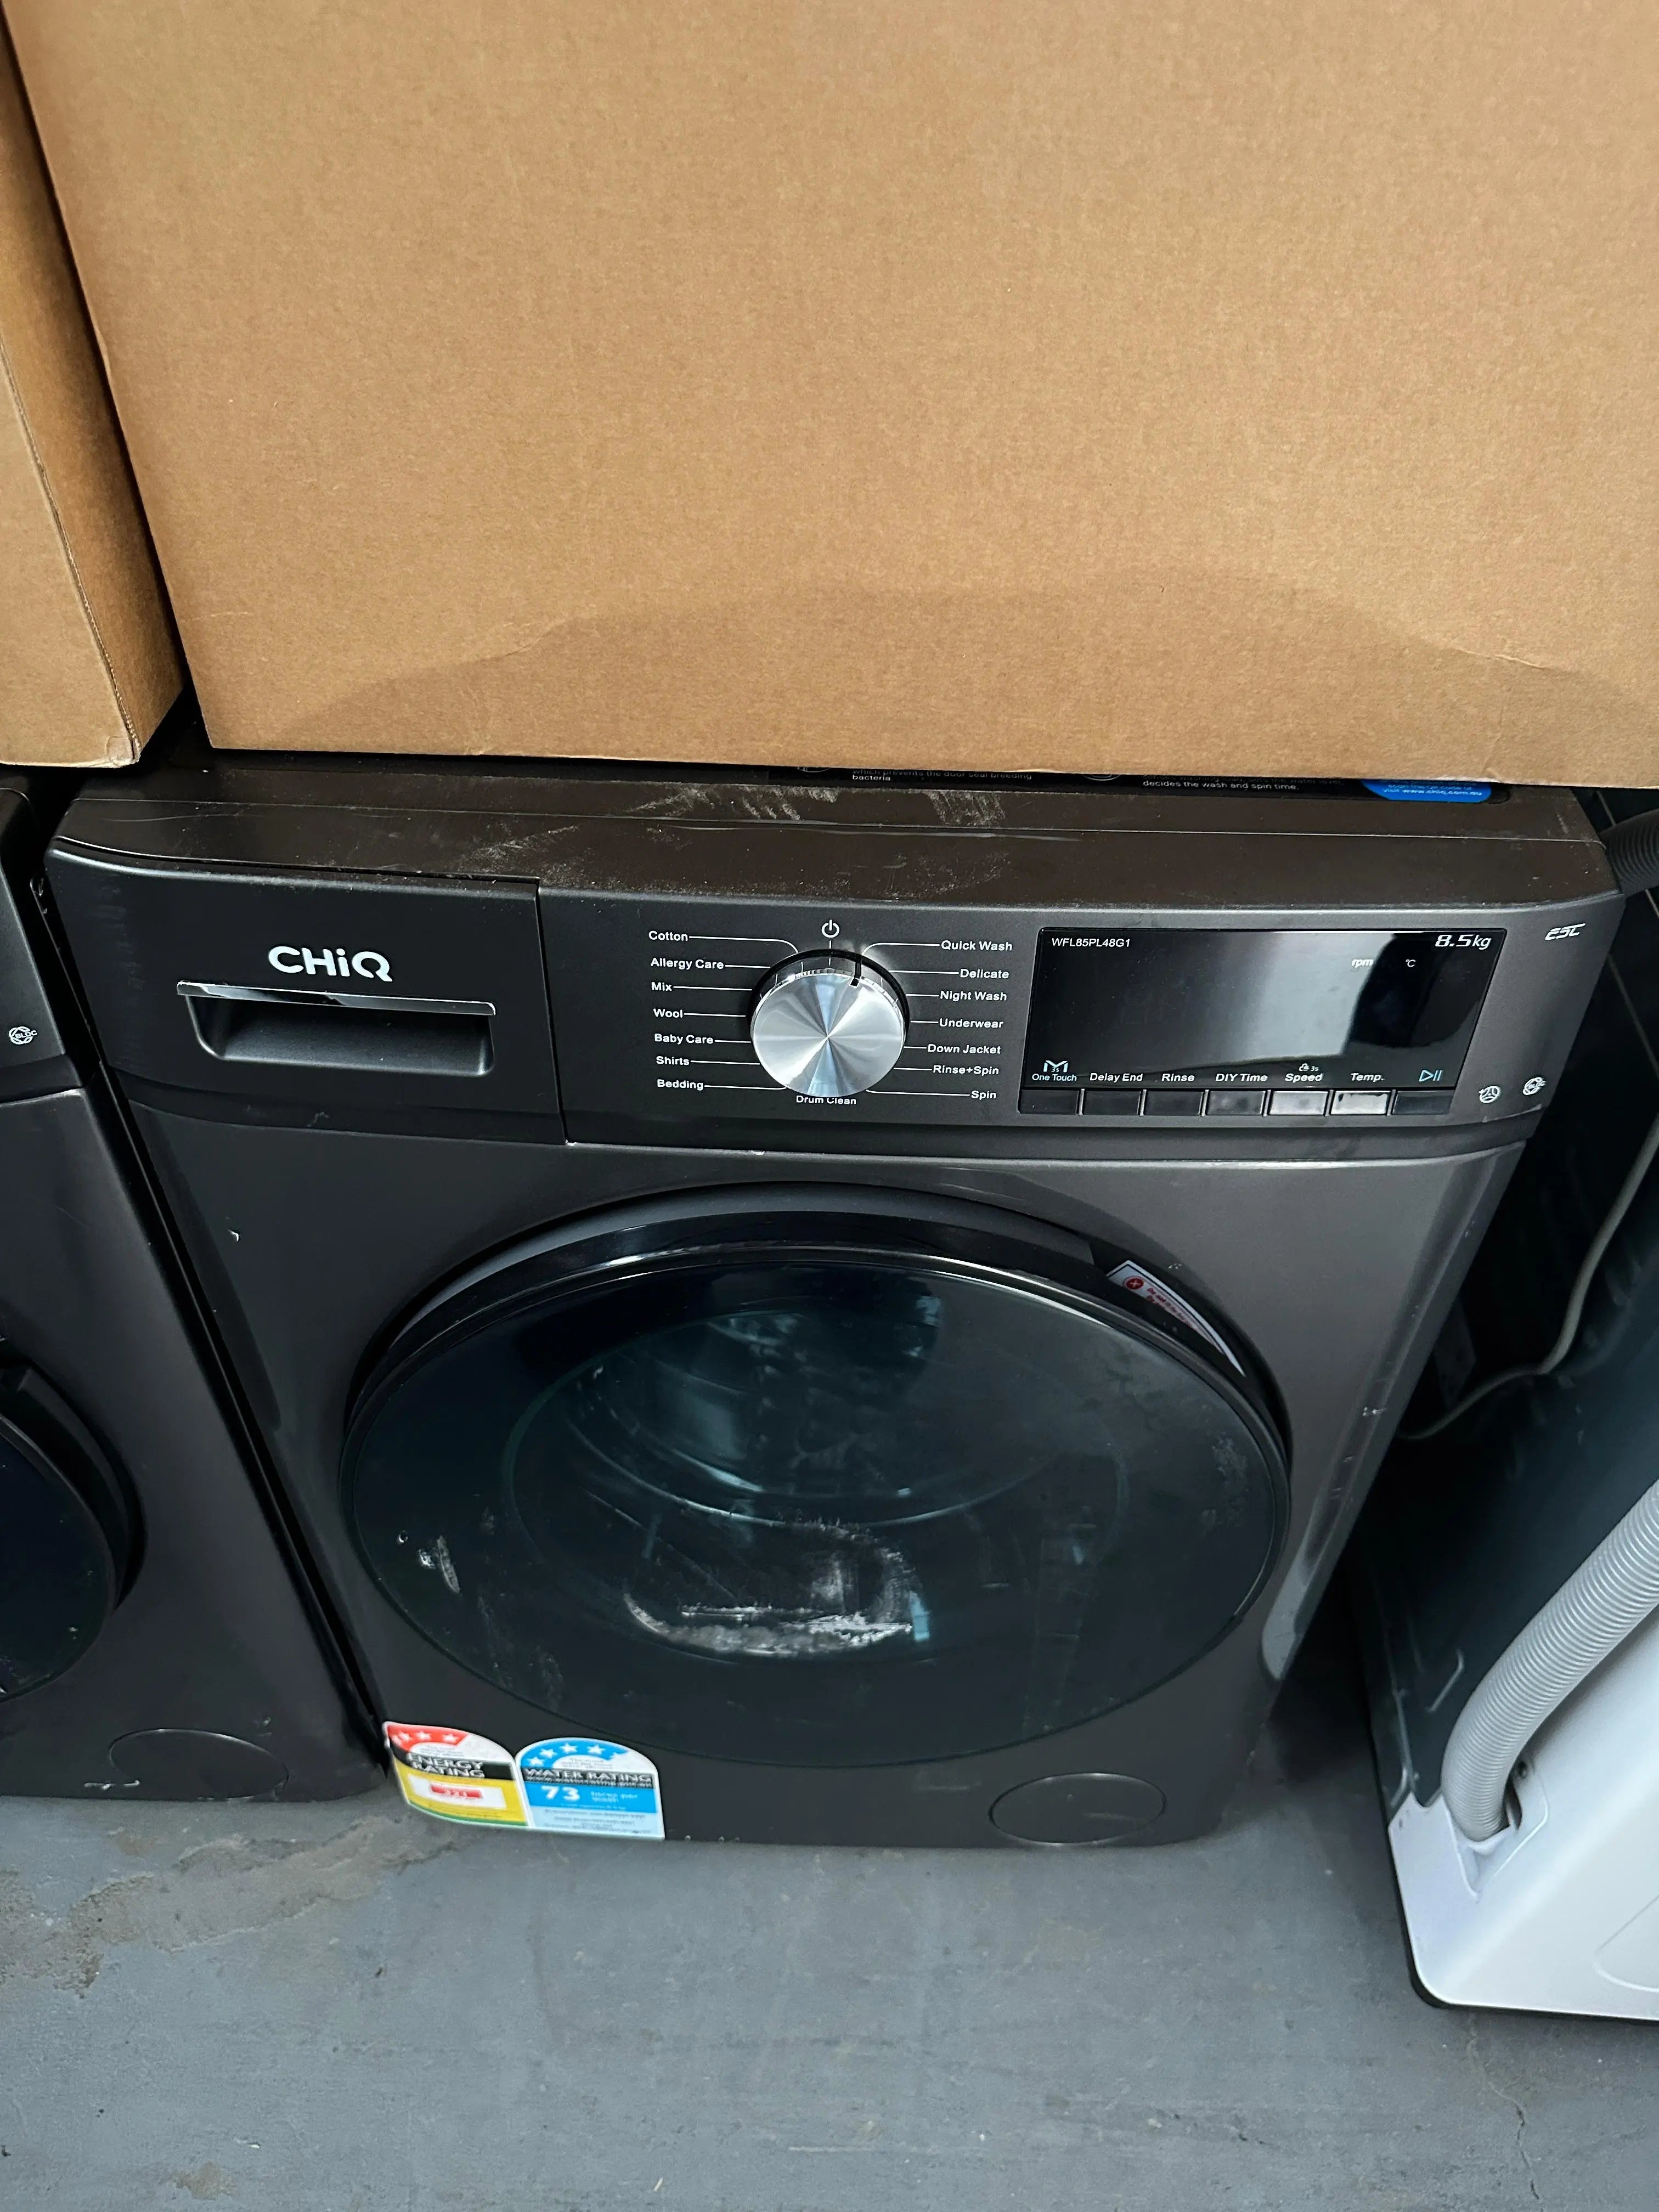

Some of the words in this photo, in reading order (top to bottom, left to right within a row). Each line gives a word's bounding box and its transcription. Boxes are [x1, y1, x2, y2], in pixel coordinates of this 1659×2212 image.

[648, 930, 689, 941] Cotton
[941, 940, 976, 951] Quick
[979, 940, 1013, 951] Wash
[1052, 937, 1131, 948] WFL85PL48G1
[1435, 934, 1492, 950] 8.5kg
[268, 946, 393, 982] CHiQ
[650, 957, 692, 969] Allergy
[695, 959, 725, 969] Care
[1351, 959, 1374, 968] rpm
[960, 968, 1009, 979] Delicate
[651, 981, 673, 991] Mix
[940, 990, 972, 1002] Night
[974, 991, 1008, 1001] Wash
[653, 1008, 683, 1018] Wool
[939, 1018, 1005, 1029] Underwear
[654, 1033, 684, 1044] Baby
[686, 1035, 714, 1044] Care
[928, 1044, 961, 1053] Down
[962, 1045, 1001, 1054] Jacket
[656, 1056, 690, 1065] Shirts
[933, 1065, 1000, 1076] Rinse+Spin
[1090, 1073, 1121, 1083] Delay
[1122, 1074, 1143, 1082] End
[1161, 1073, 1195, 1082] Rinse
[1215, 1074, 1239, 1082] DIY
[1239, 1074, 1268, 1082] Time
[1284, 1073, 1324, 1083] Speed
[1350, 1073, 1386, 1083] Temp.
[657, 1079, 704, 1091] Bedding
[796, 1095, 824, 1104] Drum
[826, 1097, 857, 1105] Clean
[970, 1090, 997, 1100] Spin
[523, 1768, 584, 1780] WATER
[586, 1771, 652, 1784] RATING
[541, 1785, 581, 1801] 73
